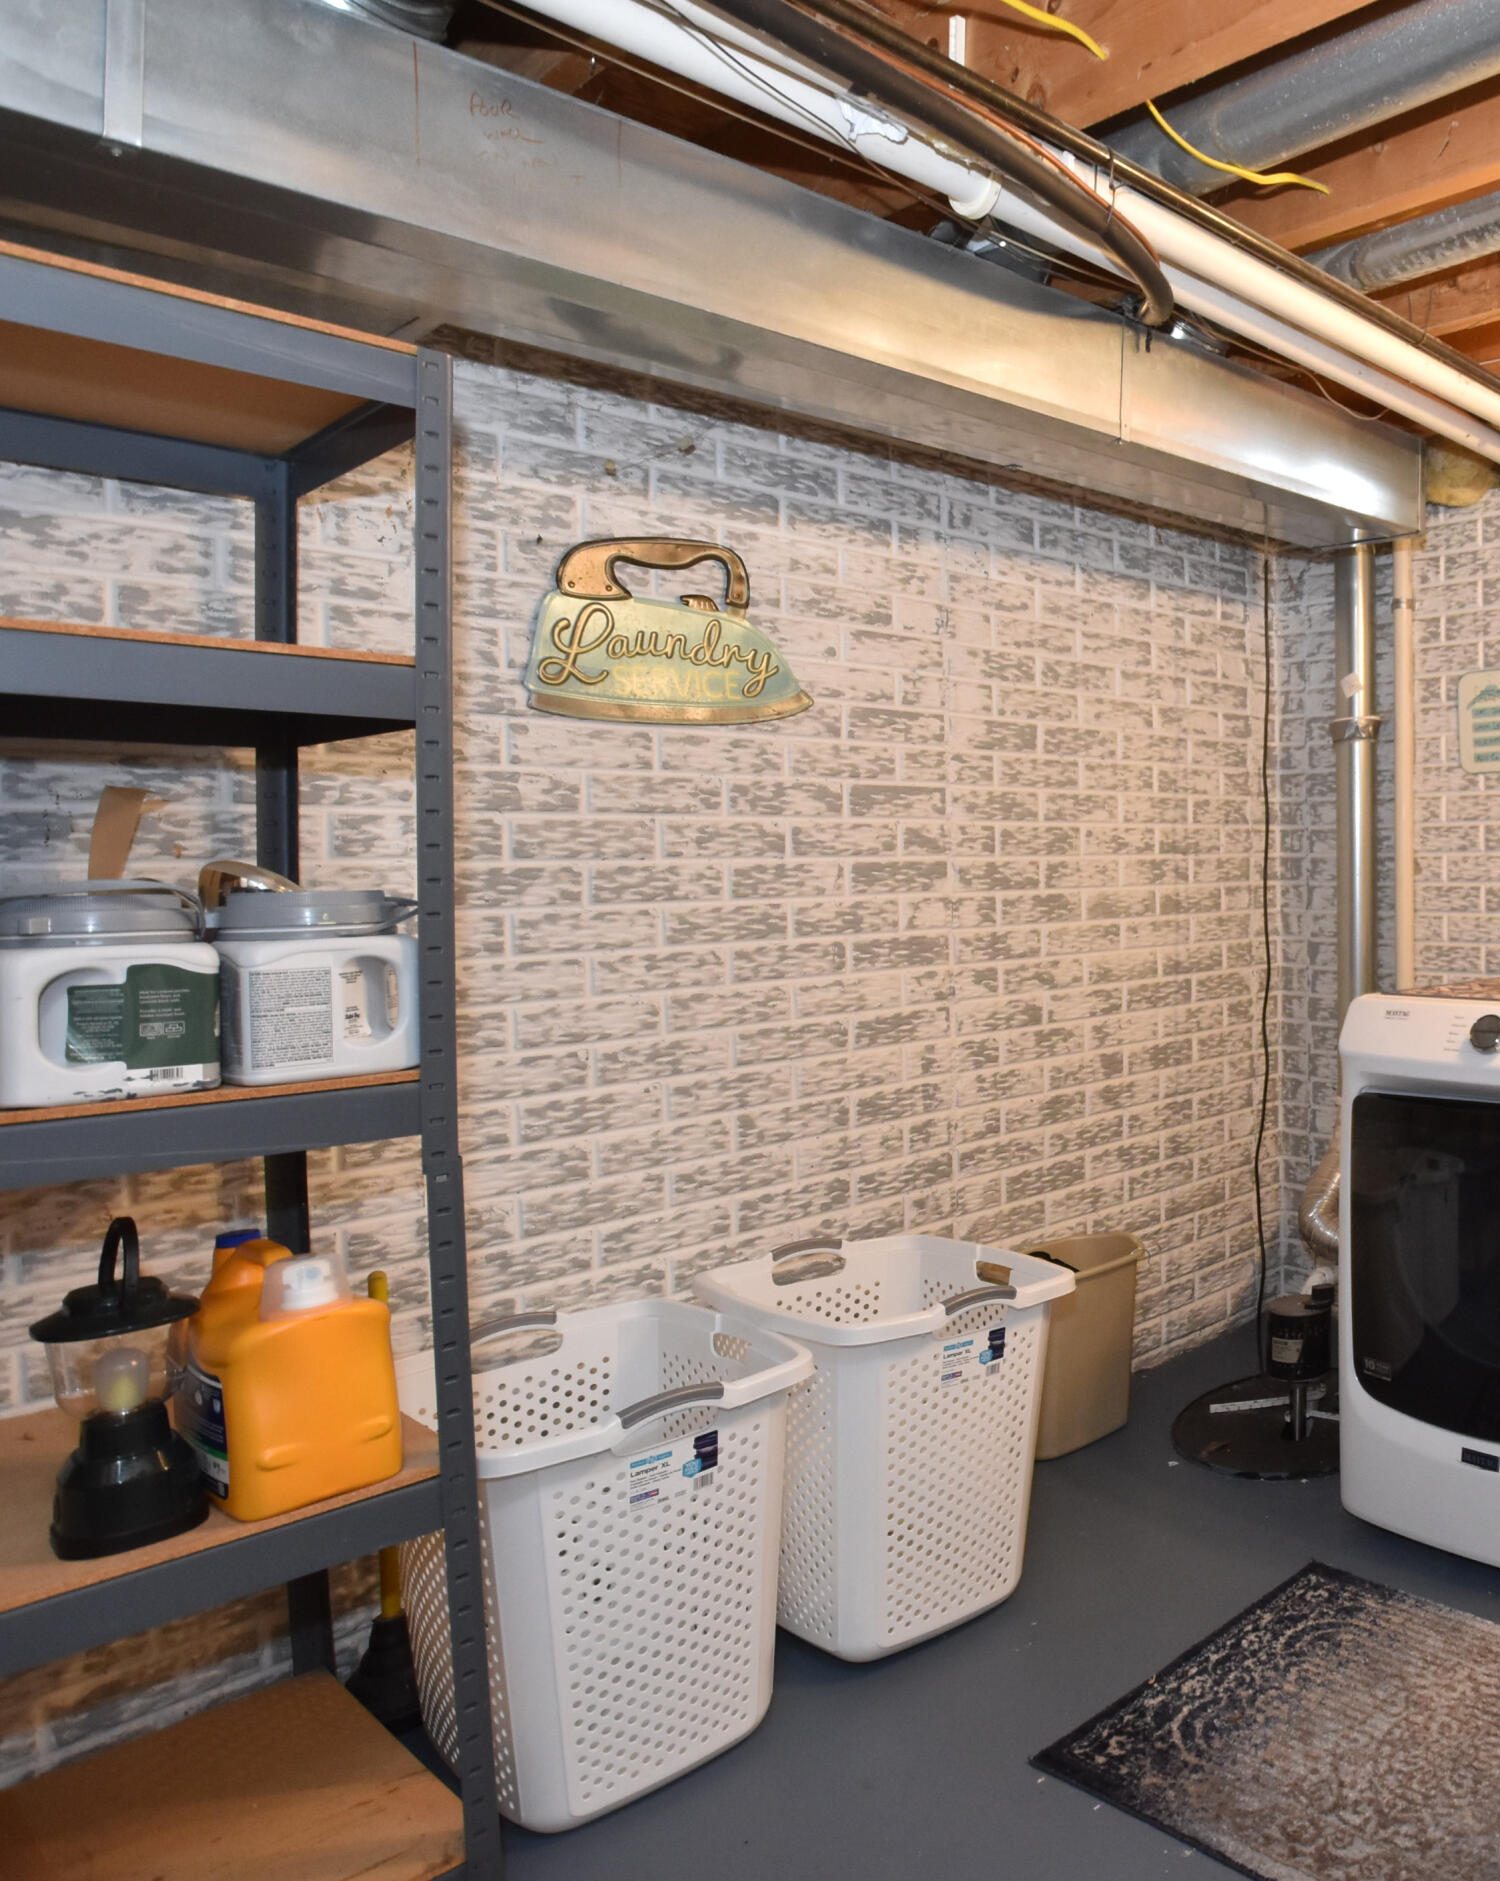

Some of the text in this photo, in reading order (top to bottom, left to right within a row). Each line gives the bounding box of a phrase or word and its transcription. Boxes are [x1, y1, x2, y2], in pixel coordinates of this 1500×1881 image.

[538, 602, 778, 698] Laundry
[612, 664, 742, 700] SERVICE
[661, 1461, 672, 1469] XL
